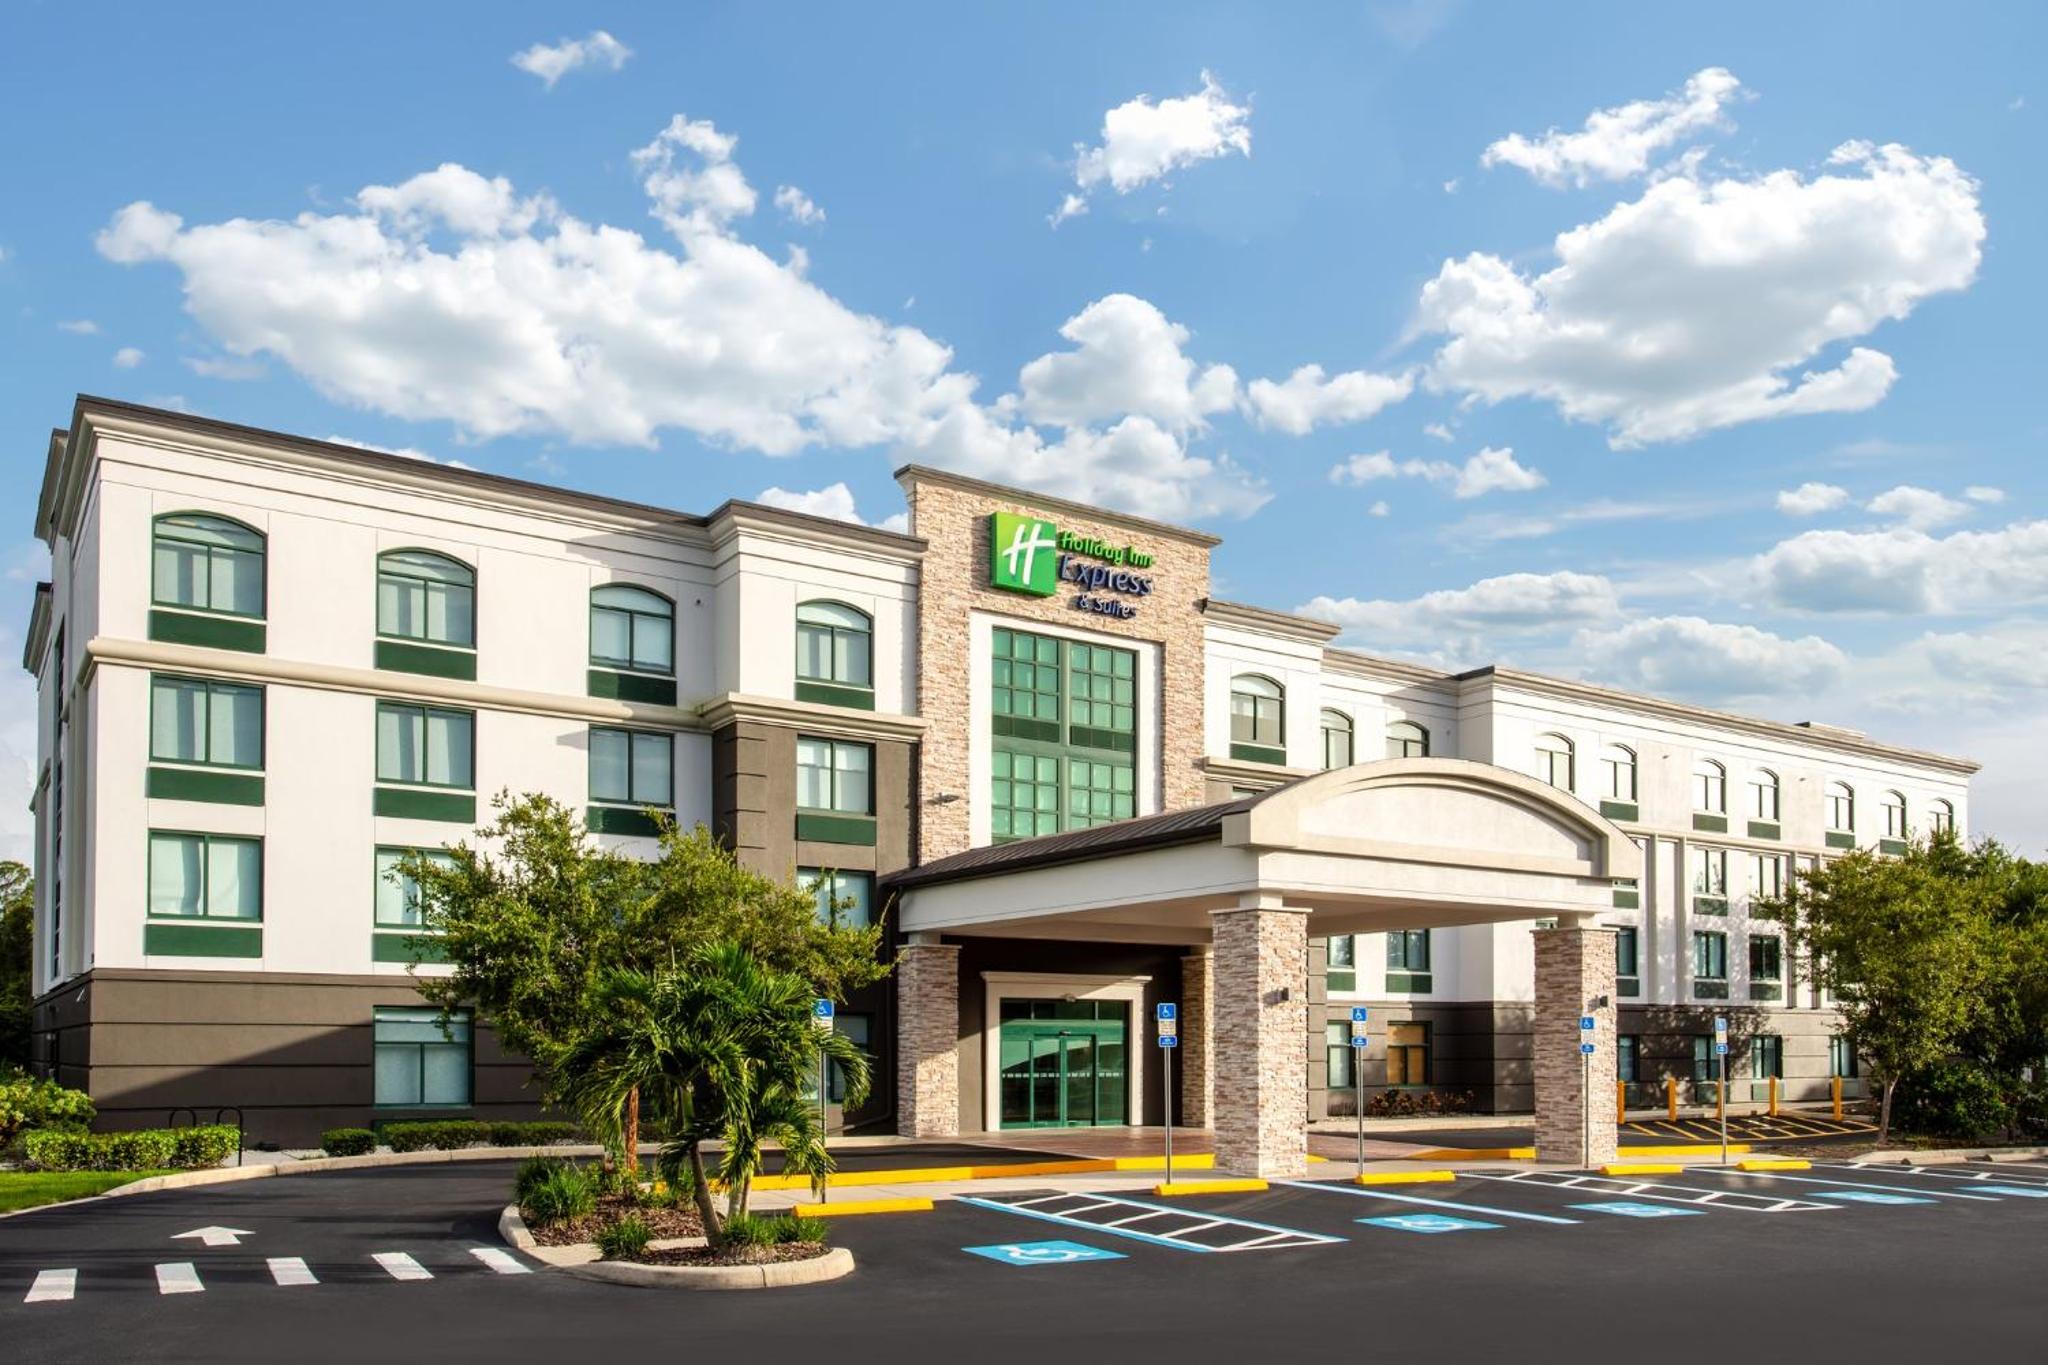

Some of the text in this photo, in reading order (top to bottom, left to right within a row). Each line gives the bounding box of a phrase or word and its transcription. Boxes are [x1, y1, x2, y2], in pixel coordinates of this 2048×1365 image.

[1061, 531, 1153, 568] Holiday Inn
[1061, 554, 1153, 595] Express
[1079, 594, 1136, 618] & Suites
